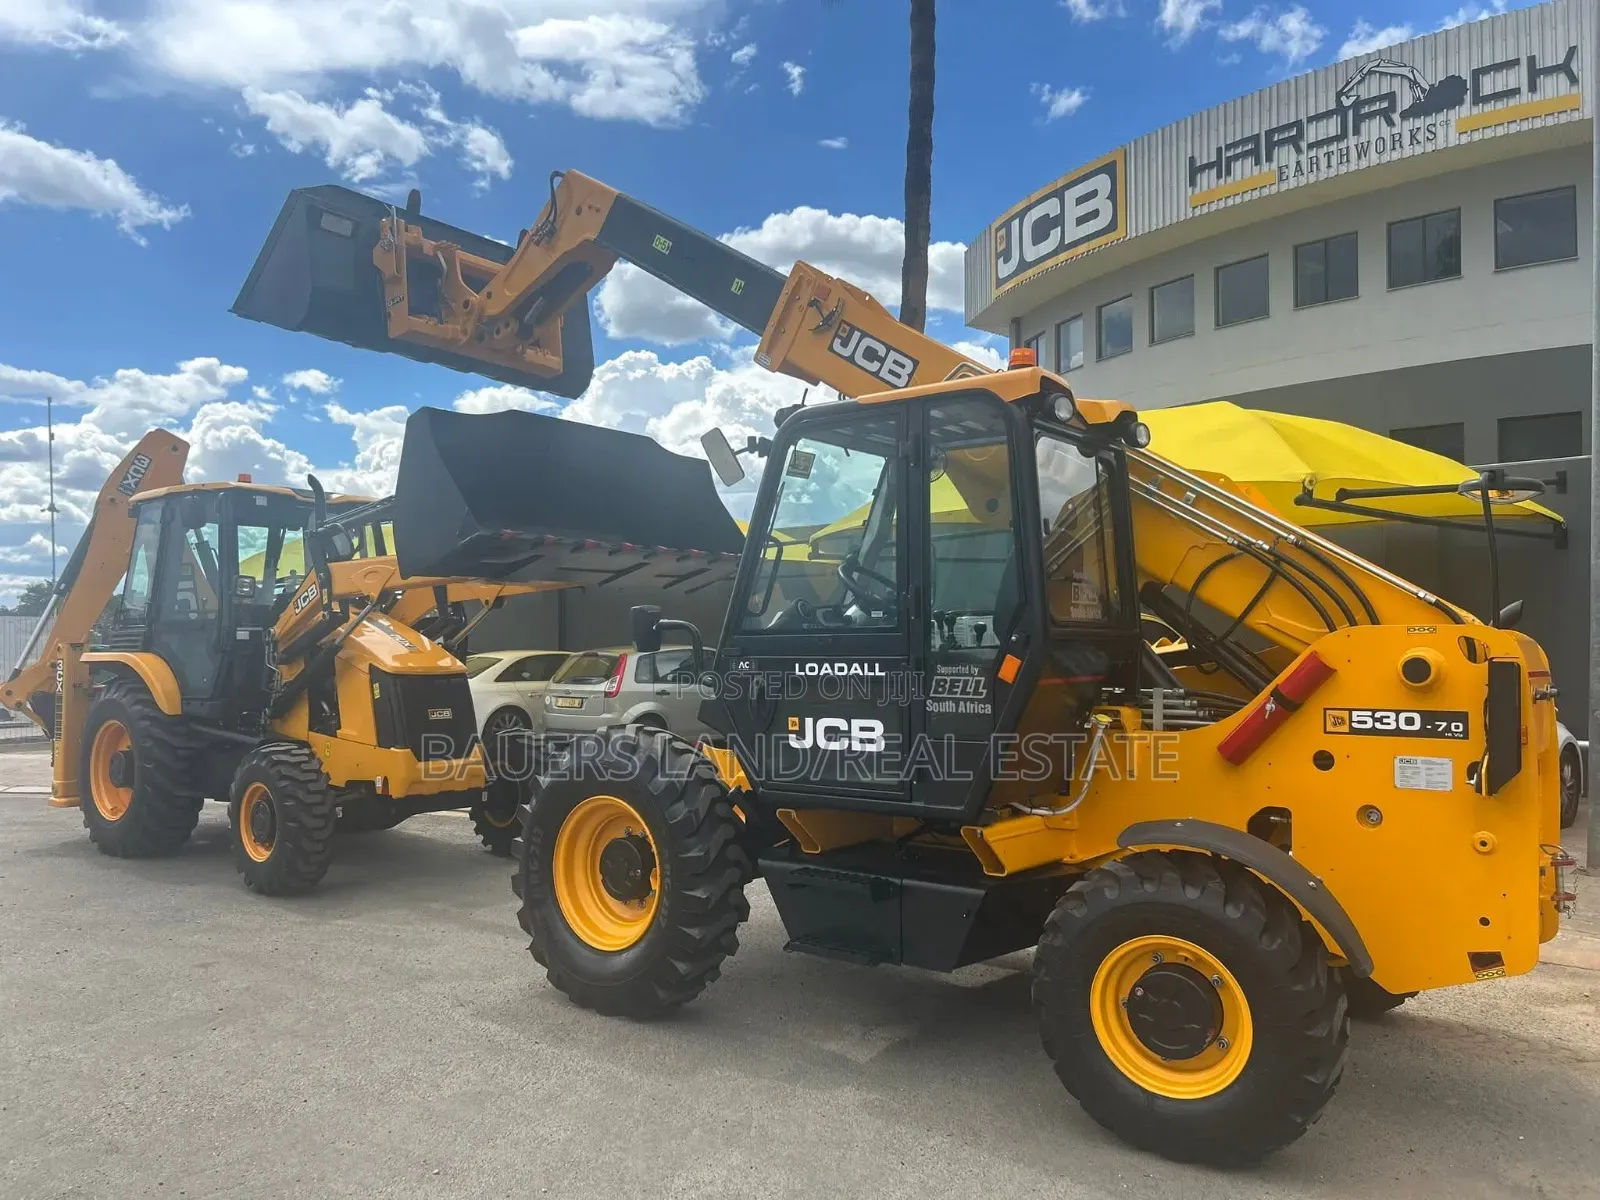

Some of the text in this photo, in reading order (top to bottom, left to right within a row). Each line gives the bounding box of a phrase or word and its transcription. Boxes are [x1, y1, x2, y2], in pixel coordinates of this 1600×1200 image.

[1189, 45, 1578, 187] HARDRCK
[1278, 123, 1437, 182] EARTHWORKS
[997, 173, 1113, 279] JCB
[832, 330, 914, 388] JCB
[294, 583, 318, 613] JCB
[738, 661, 750, 669] AC
[795, 662, 886, 676] LOADALL
[936, 664, 979, 676] Supported by
[930, 675, 988, 699] BELL
[430, 710, 451, 718] JCB
[926, 699, 992, 714] South Africa
[788, 717, 886, 752] JCB
